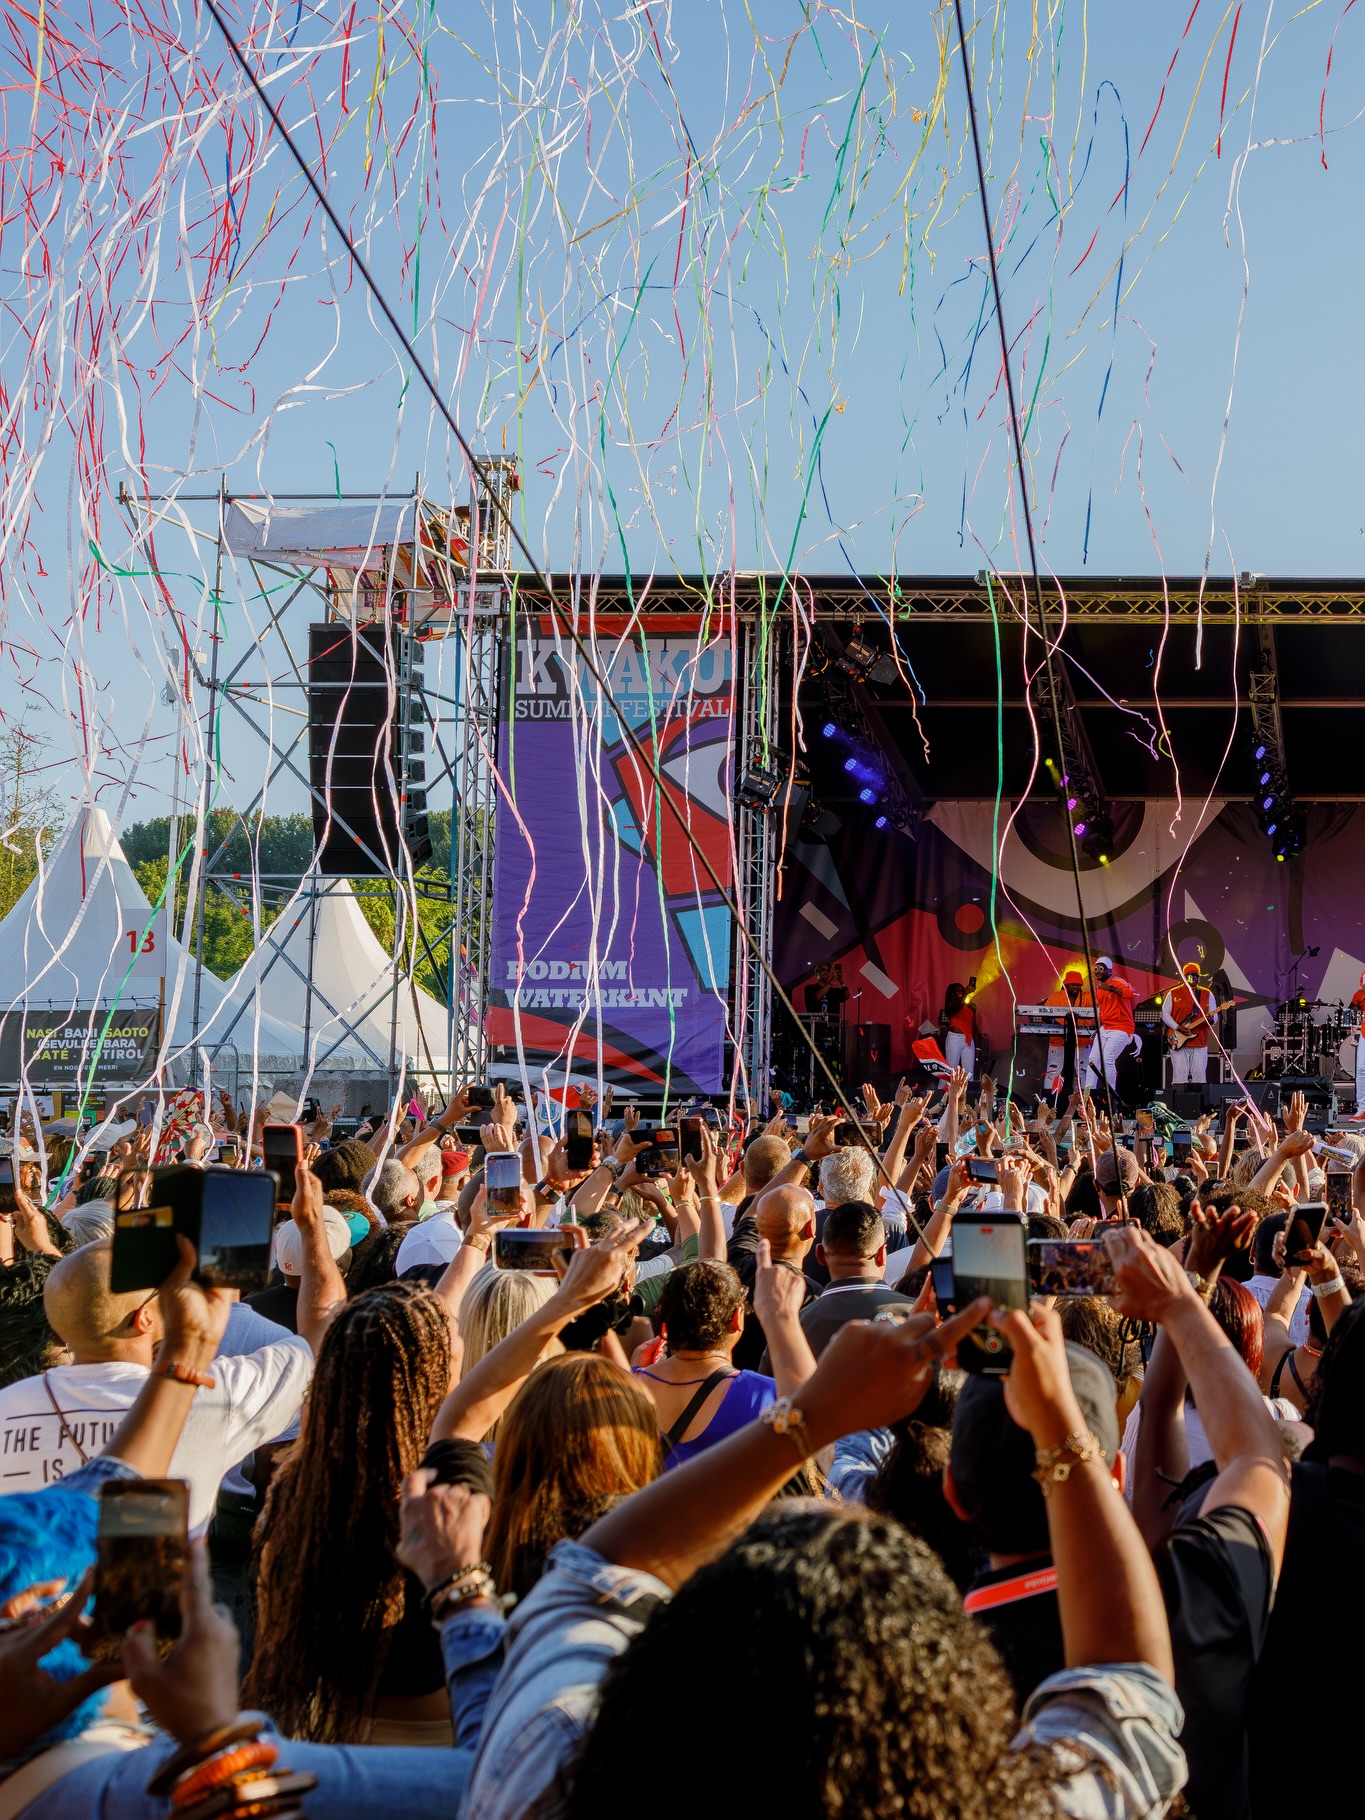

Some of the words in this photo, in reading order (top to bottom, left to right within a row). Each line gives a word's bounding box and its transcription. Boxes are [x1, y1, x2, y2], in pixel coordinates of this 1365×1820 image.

[515, 639, 730, 695] KWAKU
[126, 930, 155, 953] 13
[506, 960, 628, 980] PODIUM
[504, 988, 688, 1008] WATERKANT
[26, 1028, 57, 1039] NASI
[105, 1027, 149, 1038] SAOTO
[103, 1038, 137, 1048] BARA
[32, 1047, 69, 1060] SATÉ
[3, 1426, 42, 1455] THE
[57, 1421, 122, 1450] FUTU
[42, 1458, 64, 1484] IS
